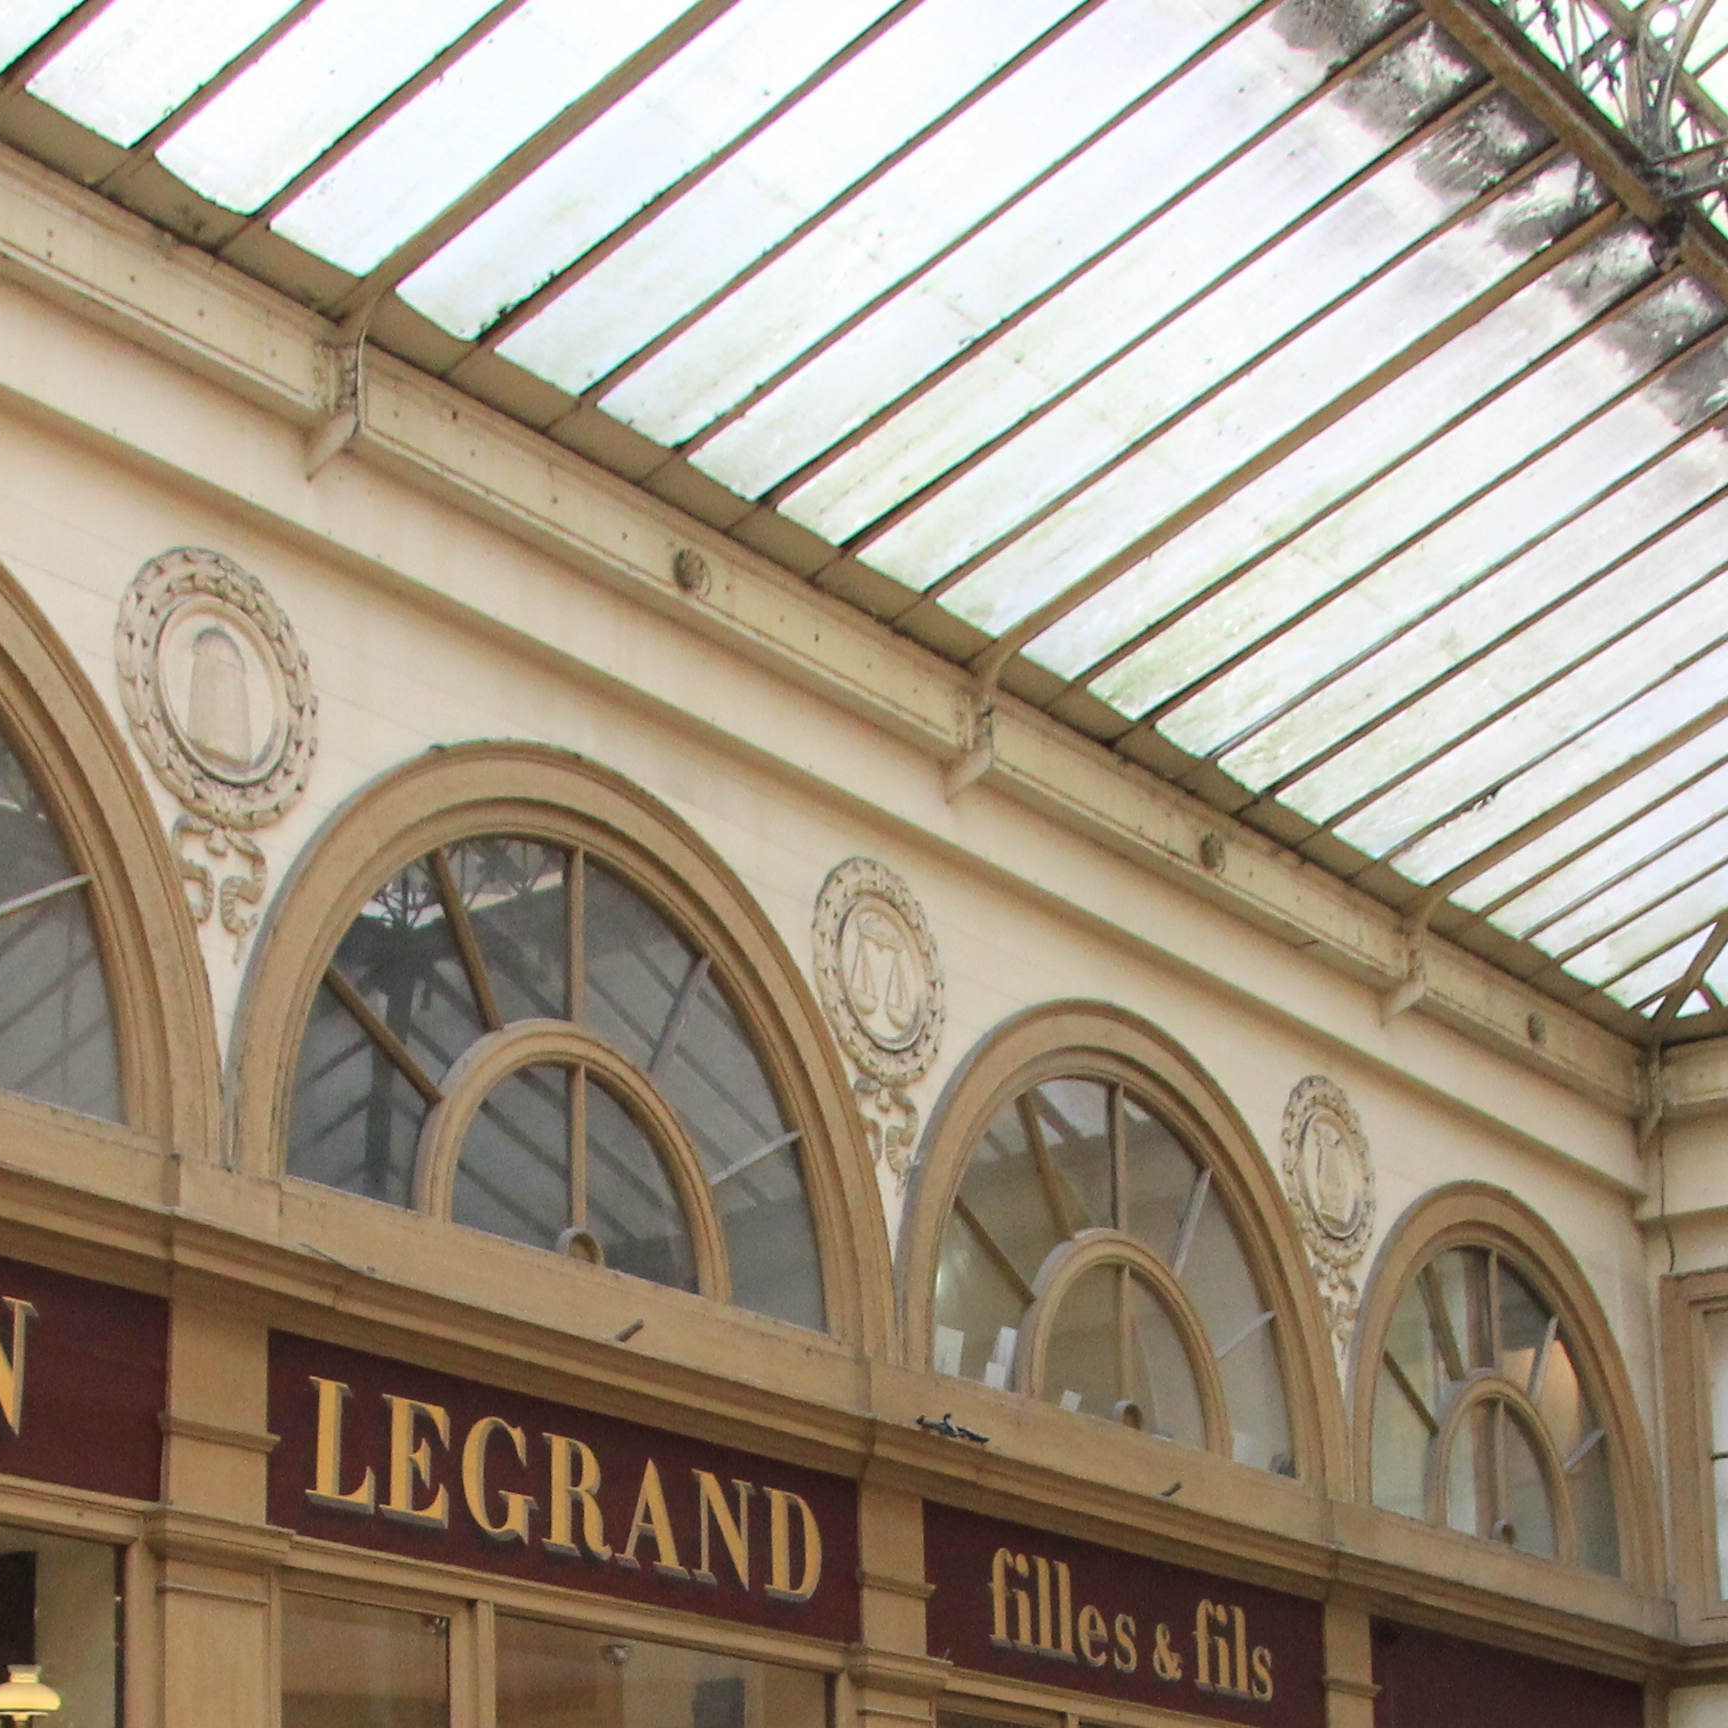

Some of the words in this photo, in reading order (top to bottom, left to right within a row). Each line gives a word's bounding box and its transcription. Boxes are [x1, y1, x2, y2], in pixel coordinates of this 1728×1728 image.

[305, 1376, 821, 1601] LEGRAND
[988, 1548, 1137, 1674] filles
[1153, 1623, 1183, 1682] &
[1192, 1599, 1272, 1701] fils
